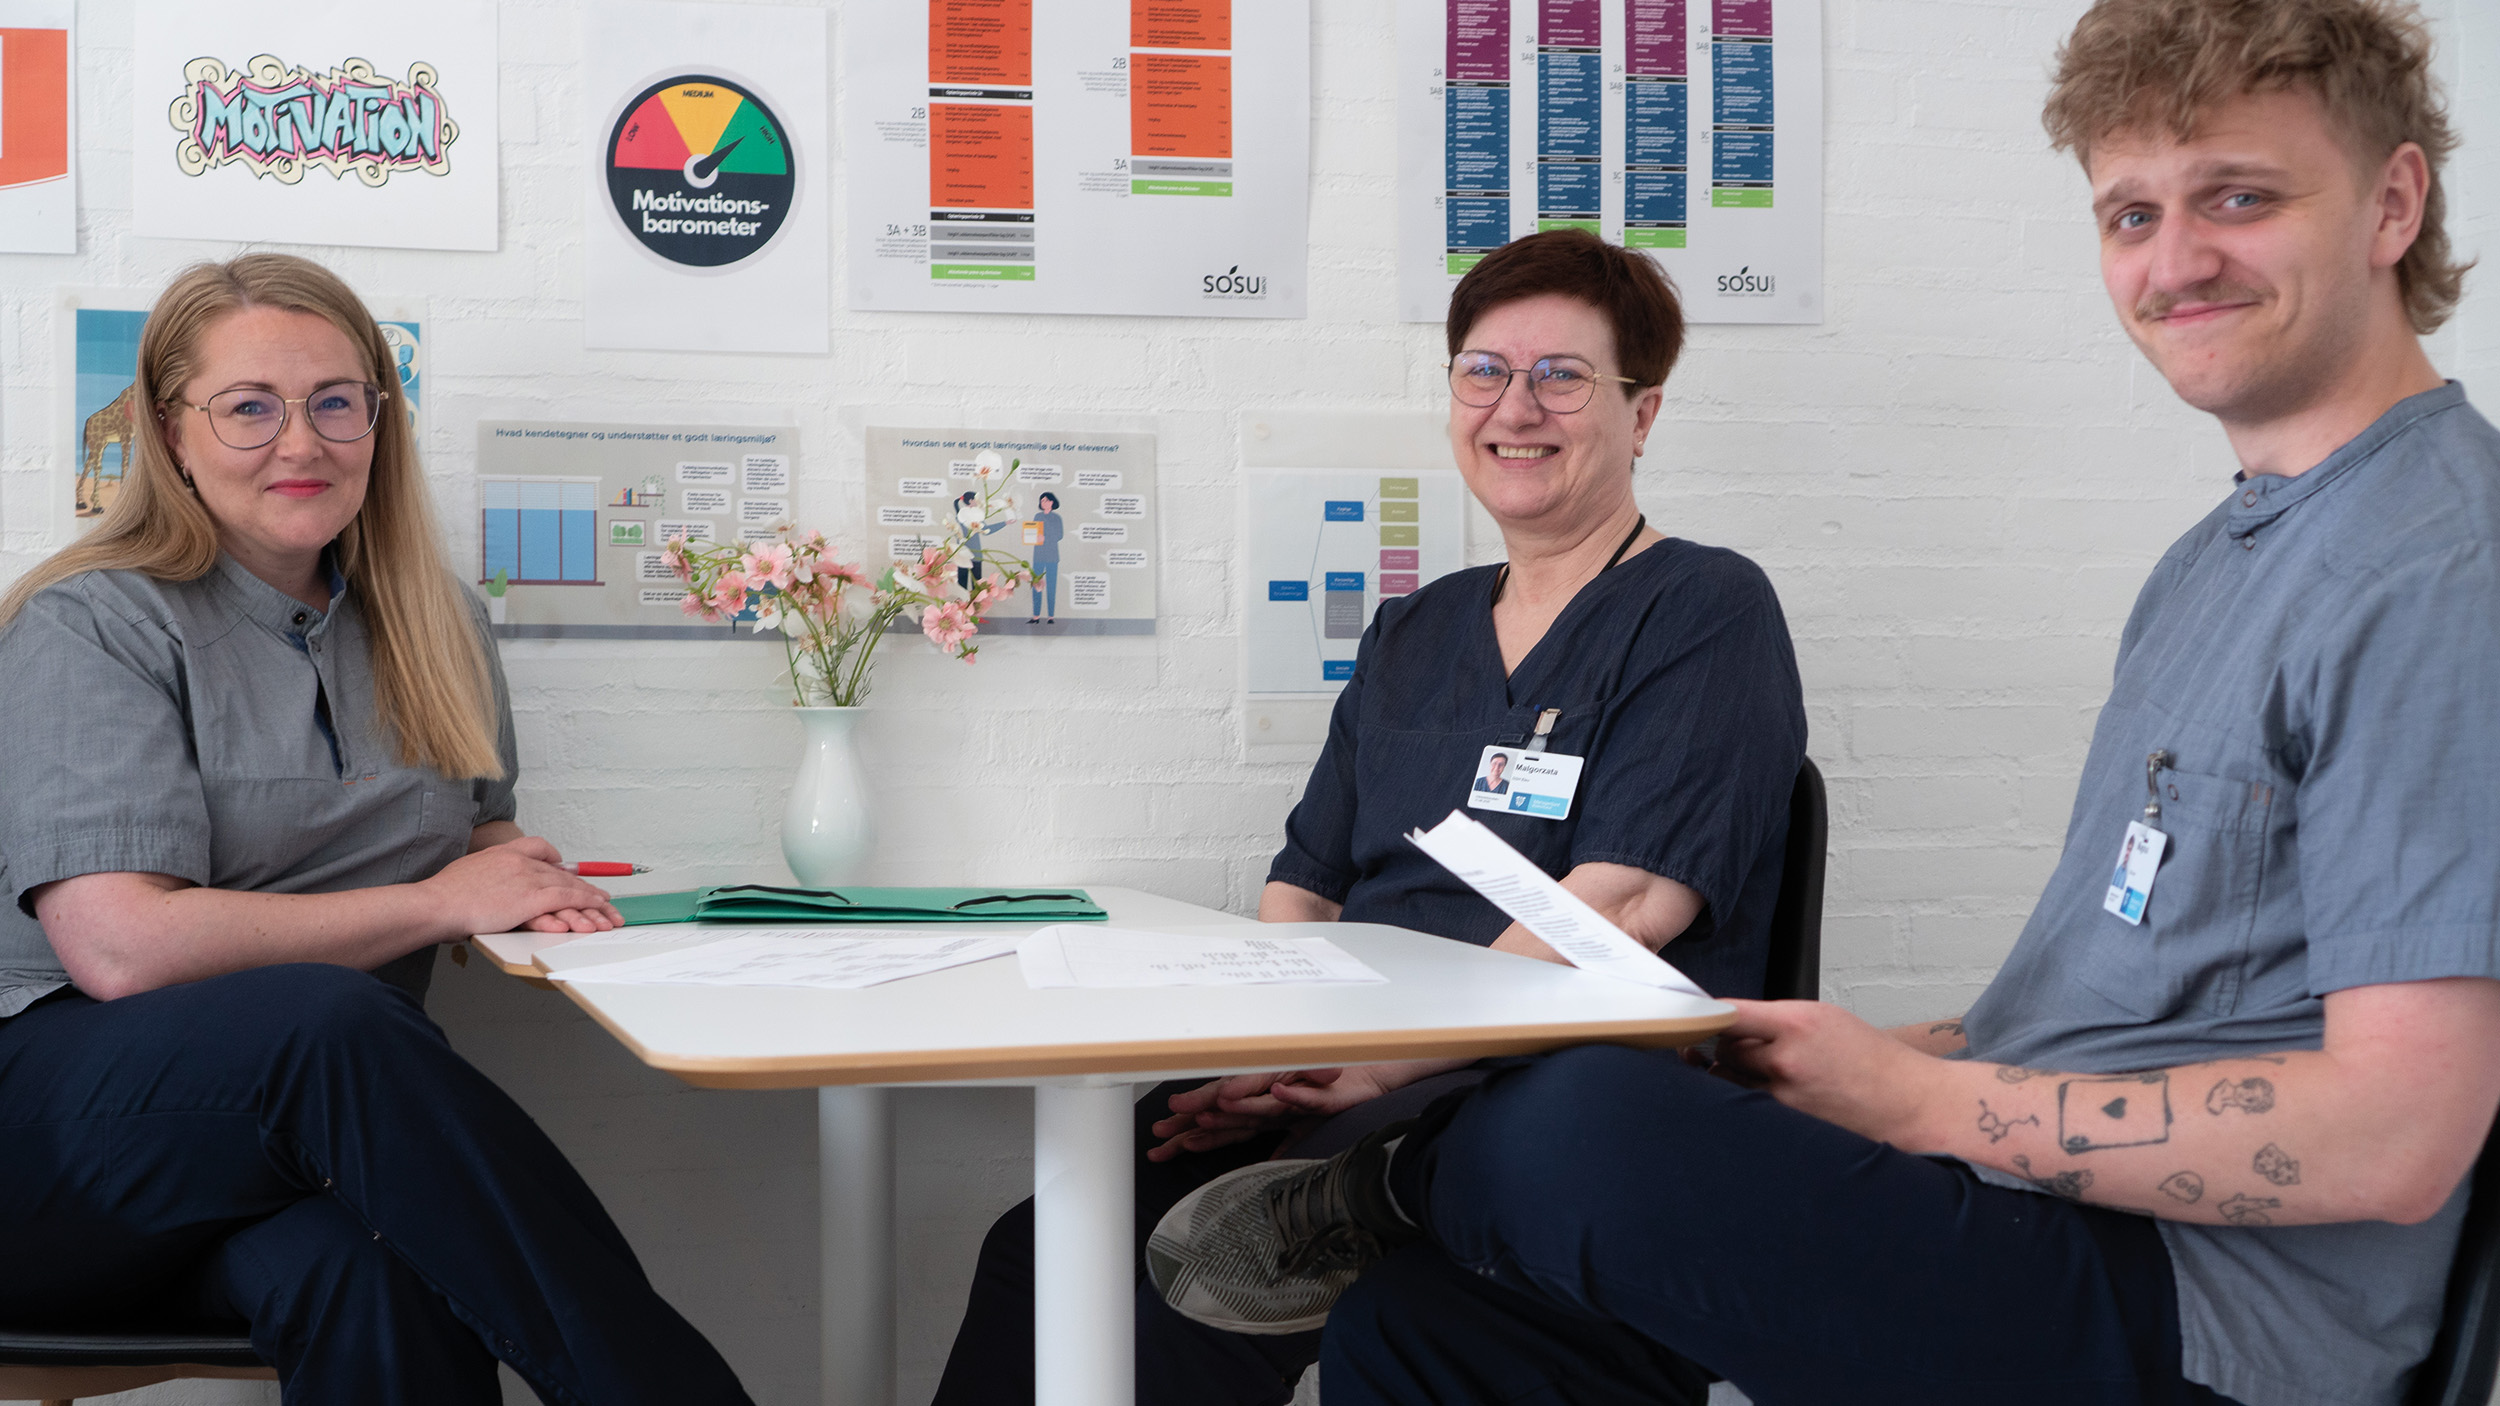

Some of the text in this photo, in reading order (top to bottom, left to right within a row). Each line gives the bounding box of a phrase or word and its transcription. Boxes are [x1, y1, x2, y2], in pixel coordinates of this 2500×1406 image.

[1112, 57, 1127, 70] 2B
[681, 89, 715, 98] MEDIUM
[911, 107, 926, 119] 2B
[626, 122, 641, 143] LOW
[759, 124, 776, 145] HIGH
[1113, 158, 1127, 170] 3A
[632, 189, 770, 214] Motivations-
[642, 210, 762, 236] barometer
[886, 224, 900, 236] 3A
[912, 224, 927, 237] 3B
[1203, 274, 1260, 294] SOSU
[1717, 274, 1769, 293] SOSU
[495, 428, 776, 444] Hvad kendetegner og understøtter et godt læringsmiljø?
[902, 439, 940, 449] Hvordan
[942, 441, 957, 449] ser
[958, 441, 968, 449] et
[969, 440, 991, 450] godt
[1050, 443, 1061, 451] ud
[1063, 443, 1076, 451] for
[1078, 443, 1119, 452] eleverne?
[1515, 764, 1559, 776] Malgorzata
